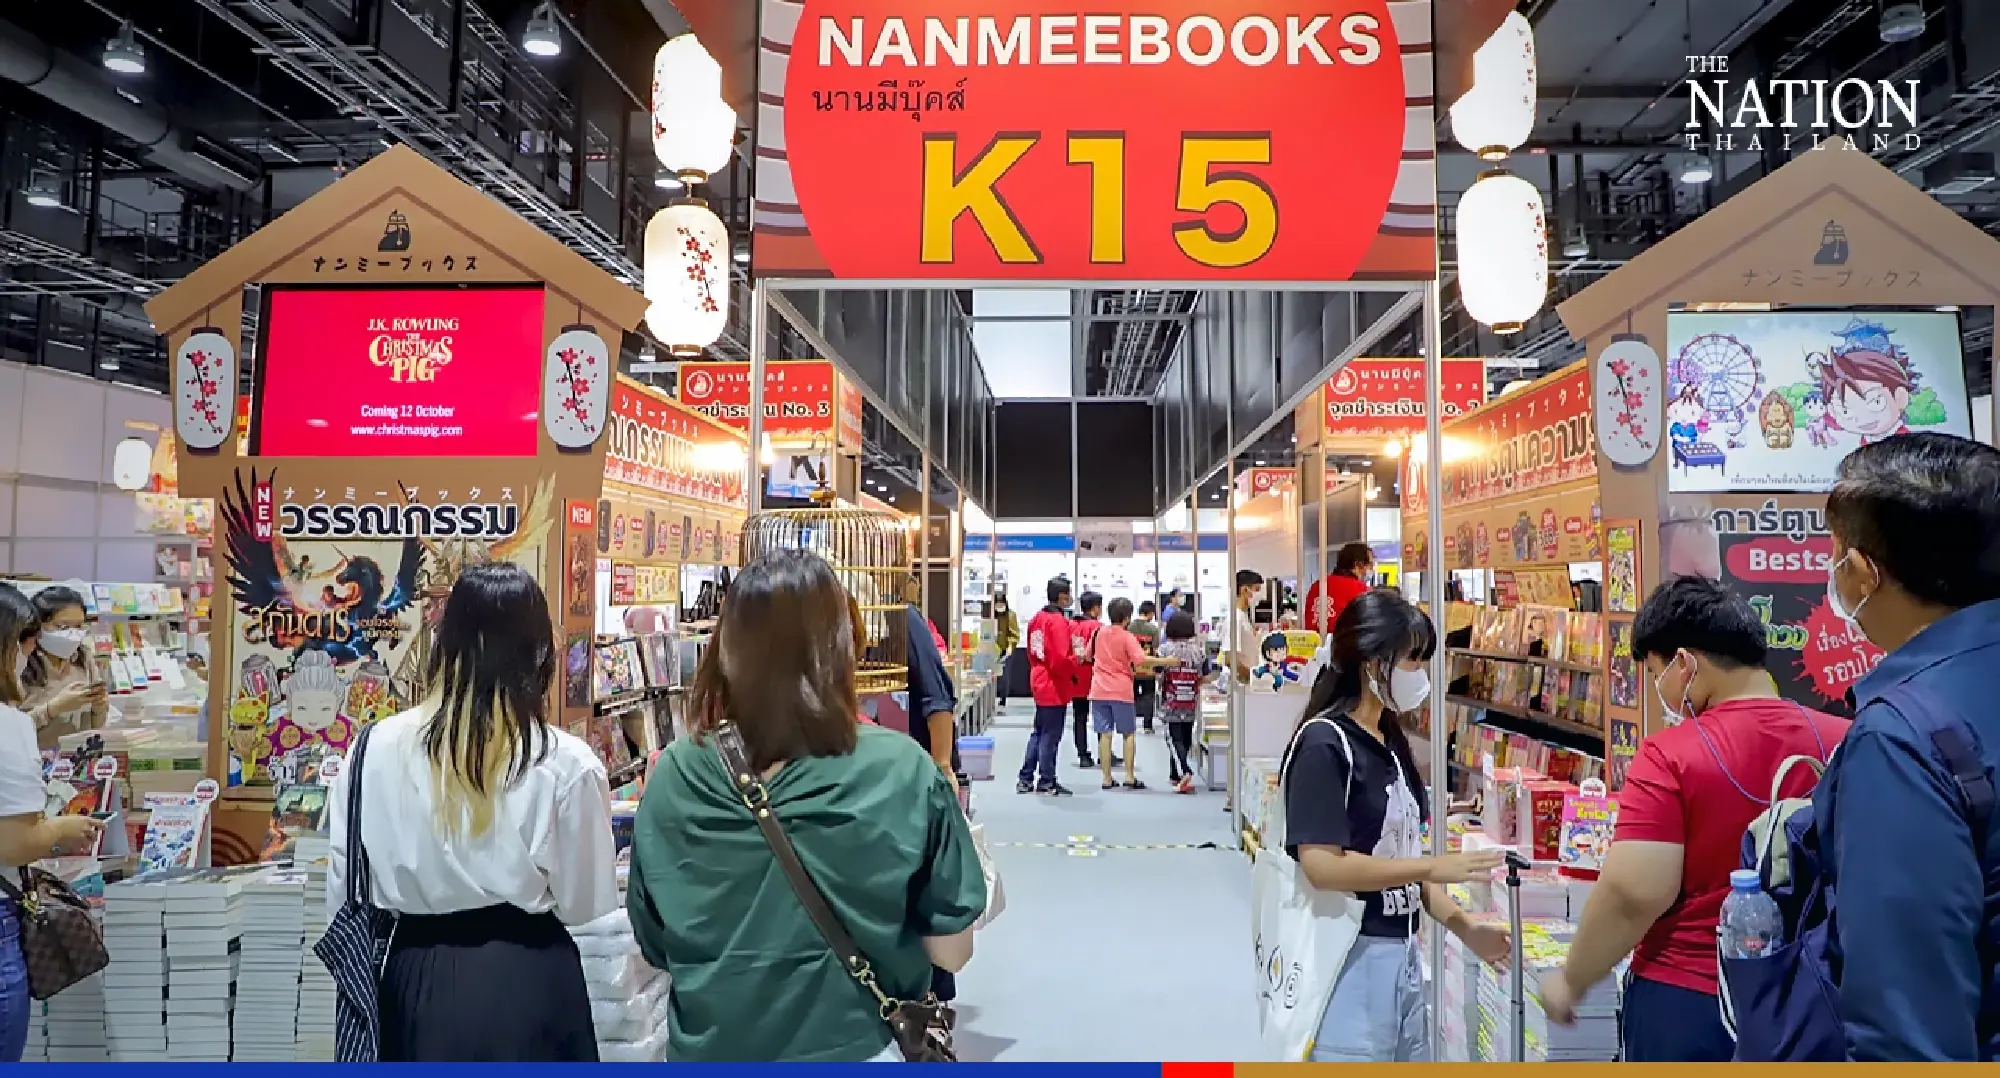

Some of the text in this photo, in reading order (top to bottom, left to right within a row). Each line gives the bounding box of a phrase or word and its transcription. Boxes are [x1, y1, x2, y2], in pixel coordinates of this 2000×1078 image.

[818, 14, 1382, 67] NANMEEBOOKS
[812, 77, 967, 121] นานมีบุ๊คส์
[919, 131, 1280, 268] K15
[313, 255, 479, 272] ナンミーブックス
[1742, 269, 1922, 288] ナンミーブックス
[392, 318, 460, 331] ROWLING
[389, 356, 437, 383] PIG
[361, 405, 456, 420] Coming 12 October
[782, 402, 815, 417] No.
[817, 401, 830, 417] 3
[350, 423, 463, 438] www.christmaspig.com
[284, 486, 514, 500] ナンミーブックス
[257, 486, 272, 537] NEW
[281, 503, 518, 537] วรรณกรรม
[572, 505, 592, 525] NEW
